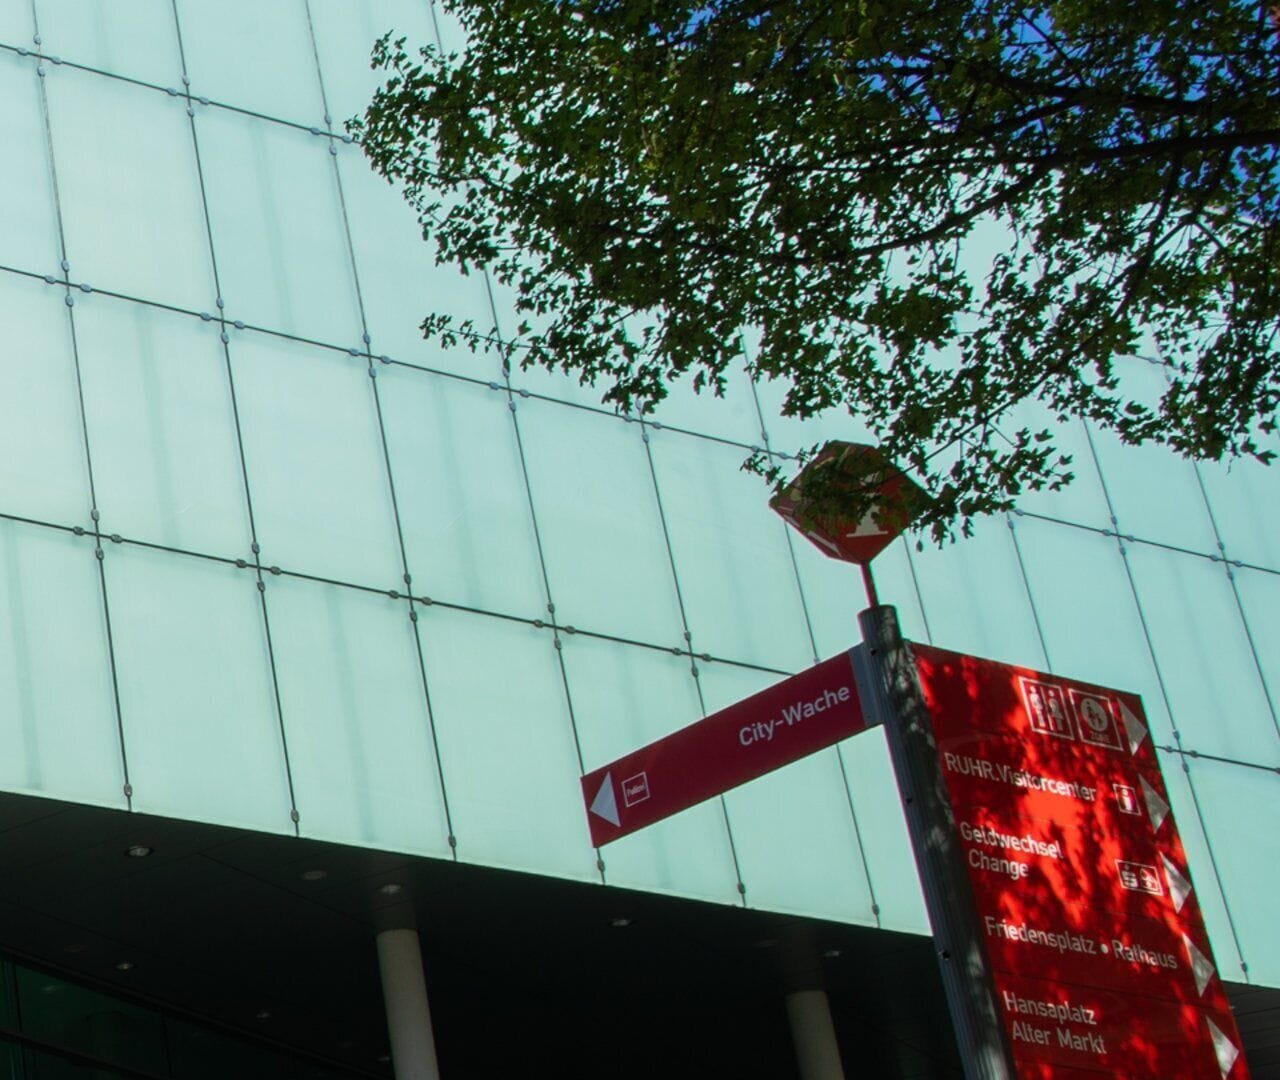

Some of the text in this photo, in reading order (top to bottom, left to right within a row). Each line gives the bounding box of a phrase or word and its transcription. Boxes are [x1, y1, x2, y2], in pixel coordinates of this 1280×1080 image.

[739, 685, 851, 747] City-Wache
[943, 752, 1097, 802] RUHR.Visitorcenter
[960, 821, 1064, 860] Geldwechsel
[968, 849, 1030, 880] Change
[984, 916, 1178, 969] Friedensplatz Rathaus
[1002, 990, 1097, 1025] Hansaplatz
[1012, 1020, 1108, 1055] Alter Markt
